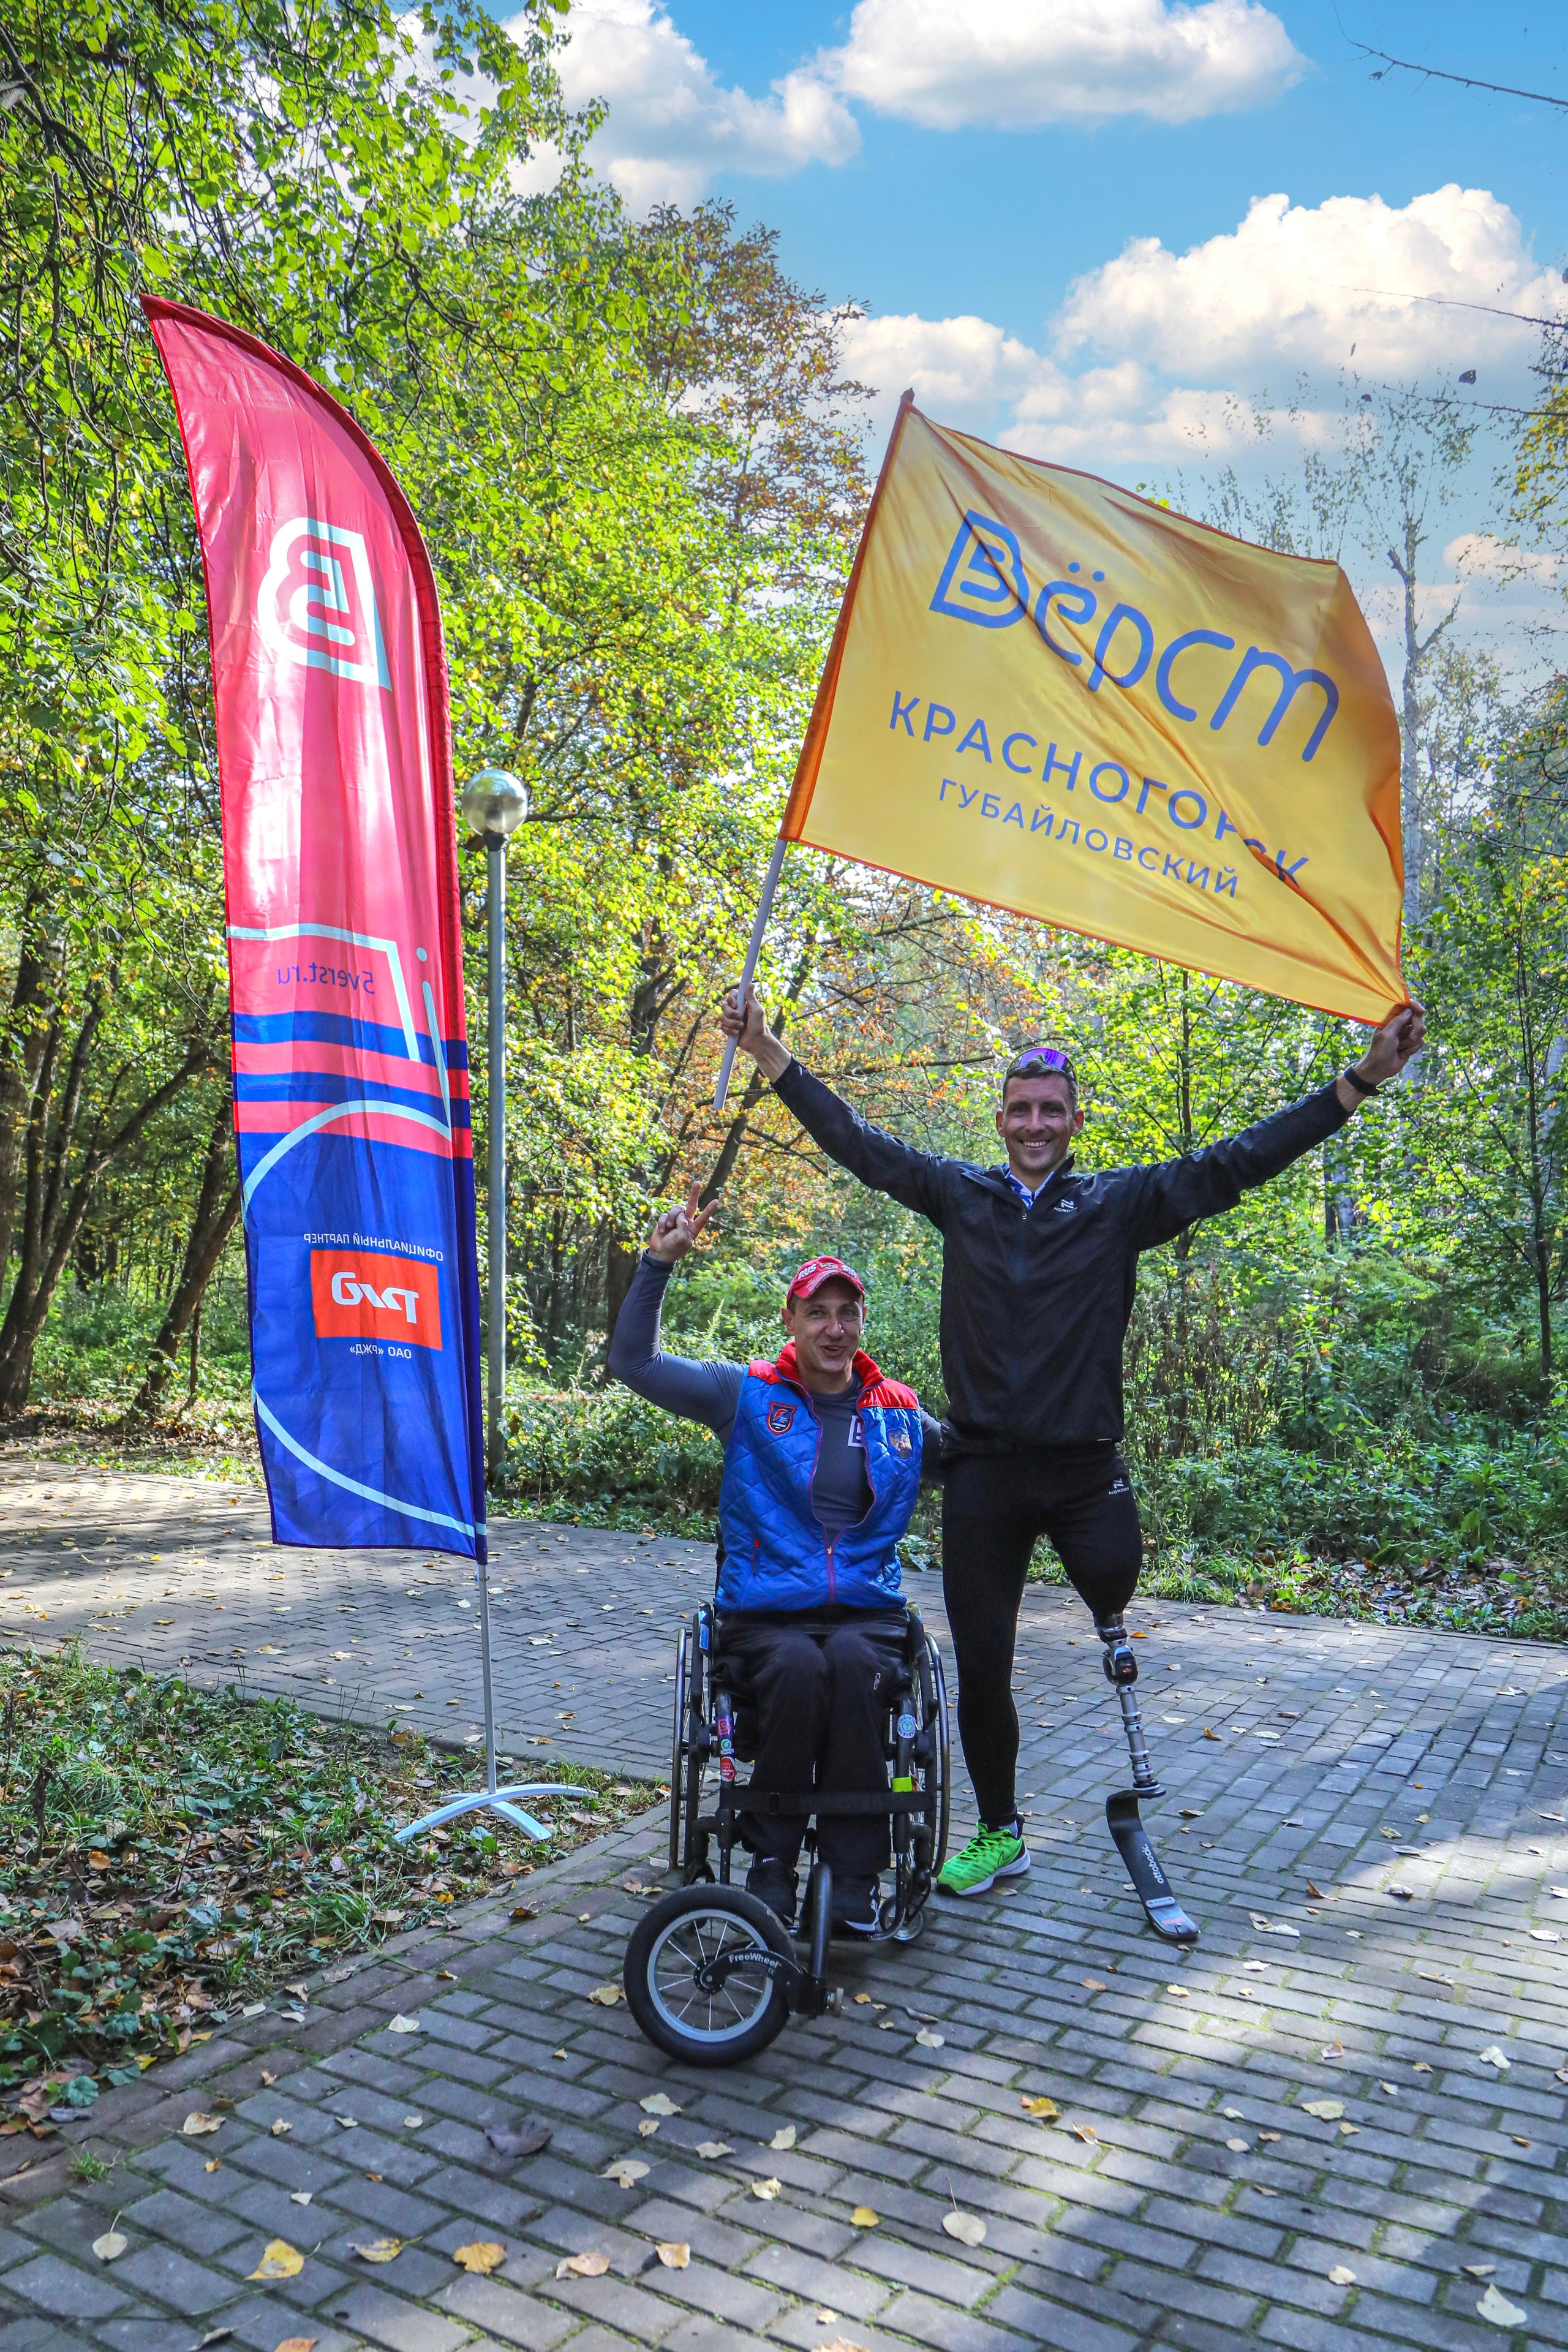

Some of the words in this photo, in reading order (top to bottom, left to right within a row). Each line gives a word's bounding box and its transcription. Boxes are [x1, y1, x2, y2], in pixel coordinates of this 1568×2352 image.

[939, 778, 1239, 898] ГУБАЙЛОВСКИЙ
[797, 1263, 817, 1281] RUS
[728, 1952, 779, 1969] FreeWheel
